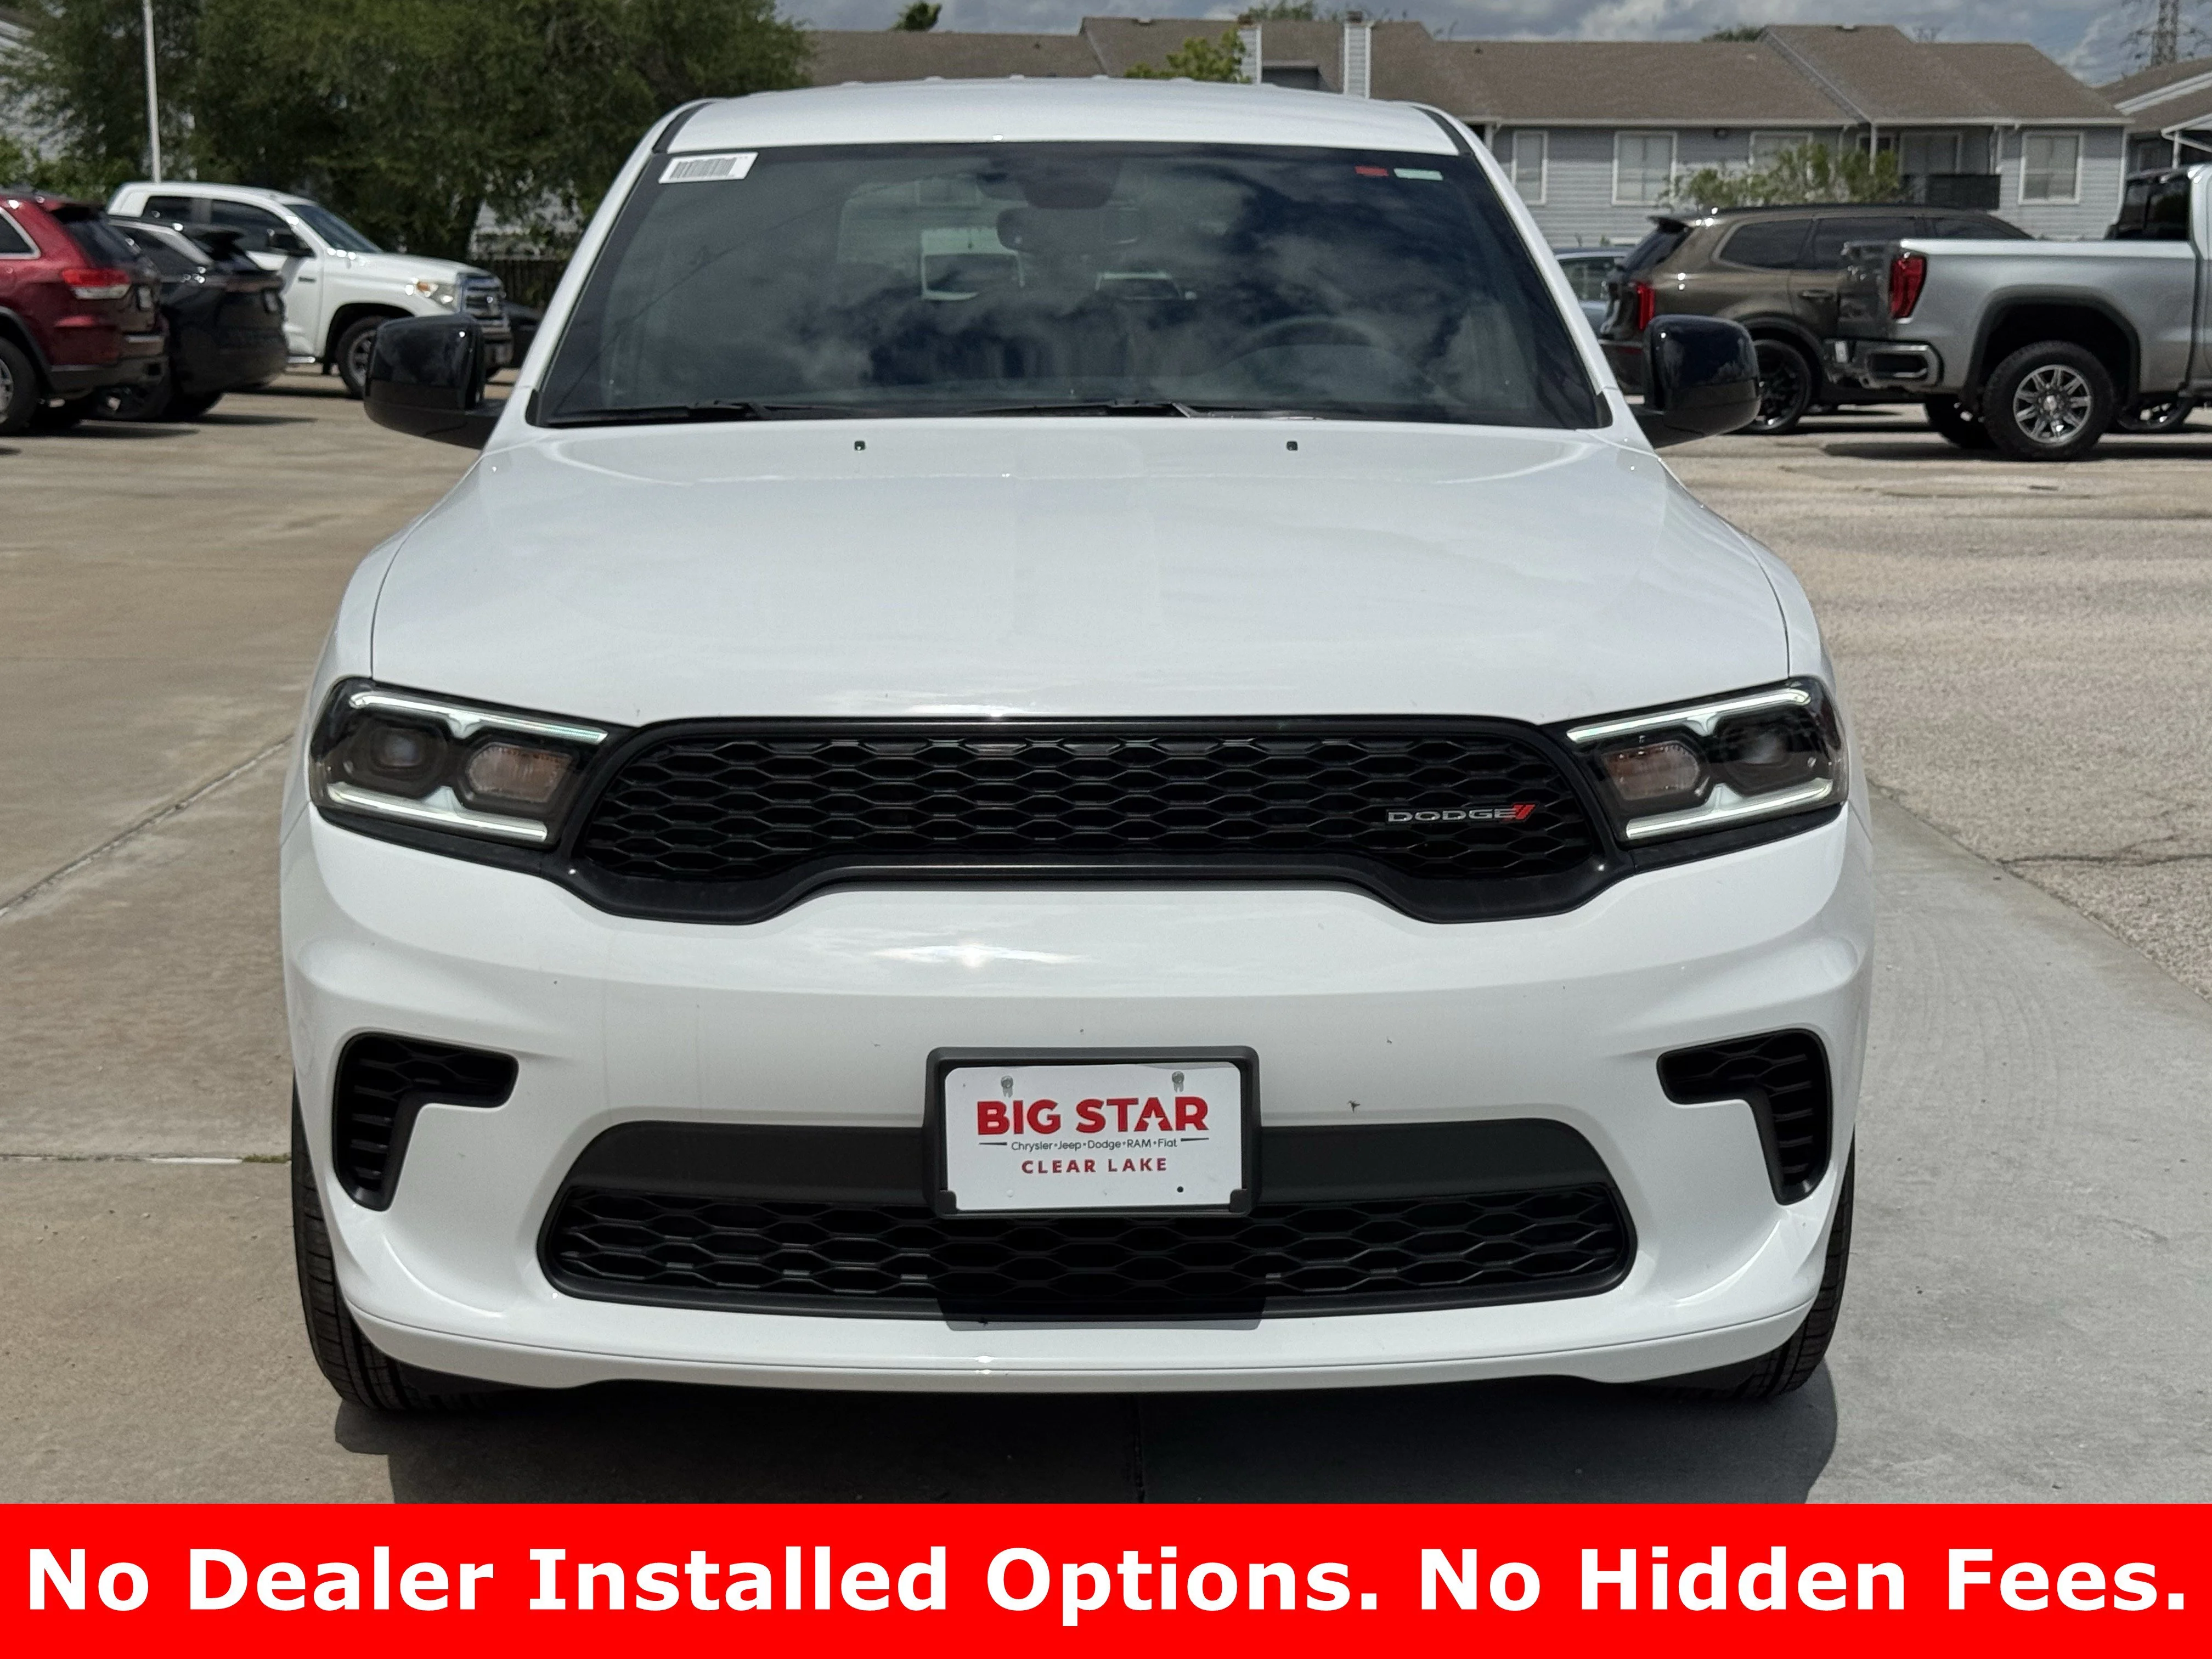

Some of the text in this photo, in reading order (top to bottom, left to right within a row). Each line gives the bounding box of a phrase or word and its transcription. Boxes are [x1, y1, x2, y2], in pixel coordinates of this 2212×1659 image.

[1388, 808, 1517, 822] DODGE
[977, 1096, 1210, 1135] BIG STAR
[1022, 1158, 1167, 1174] CLEAR LAKE
